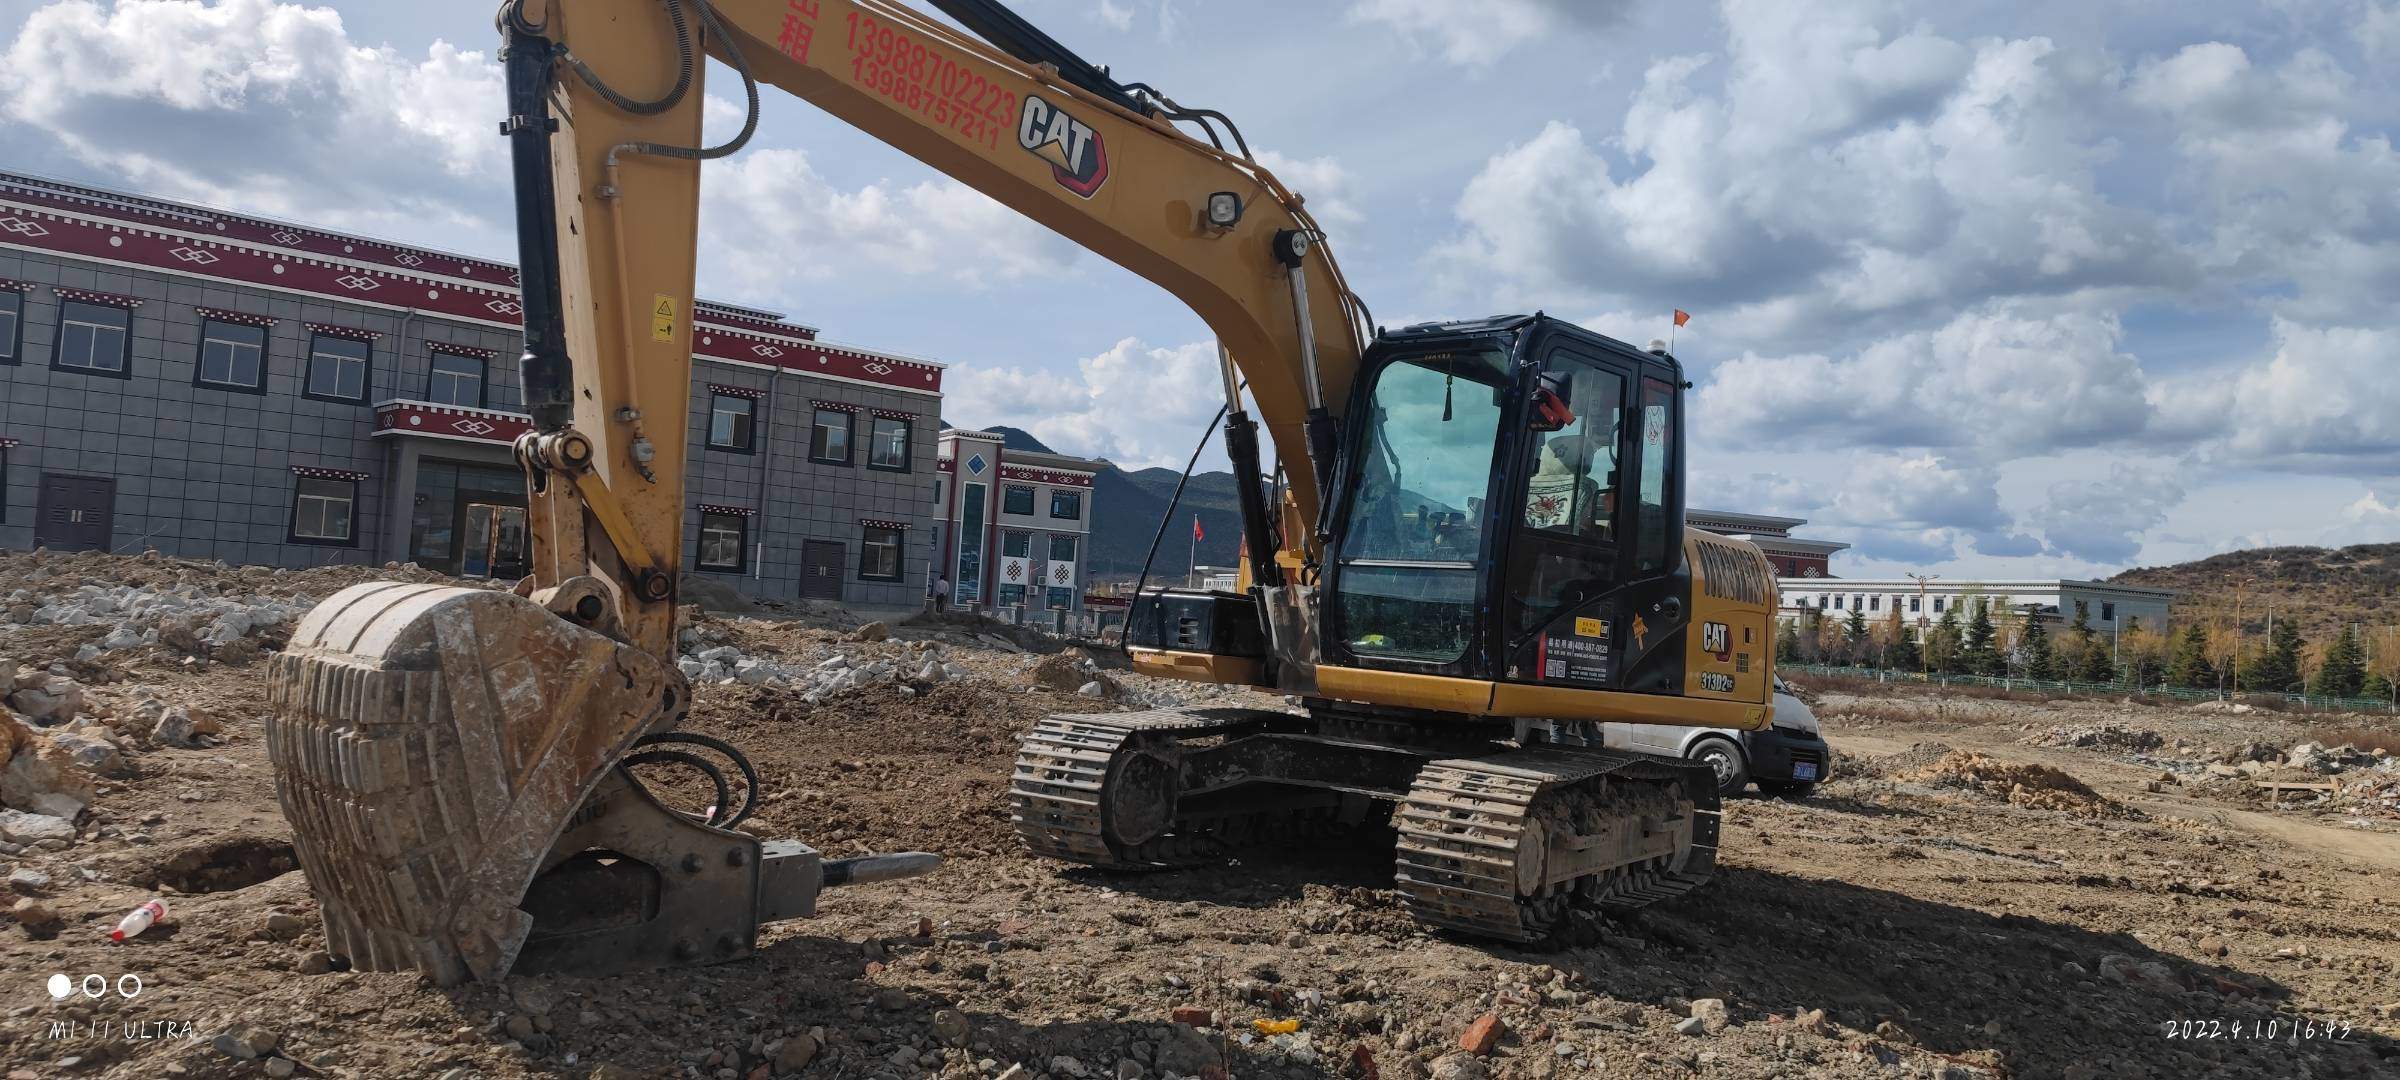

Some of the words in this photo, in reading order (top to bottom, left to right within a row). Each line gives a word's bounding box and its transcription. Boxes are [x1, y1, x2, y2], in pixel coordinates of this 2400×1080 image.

[847, 12, 1016, 129] 13988702223
[852, 55, 1000, 151] 13988757211
[1019, 95, 1094, 175] CAT
[1703, 622, 1727, 652] CAT
